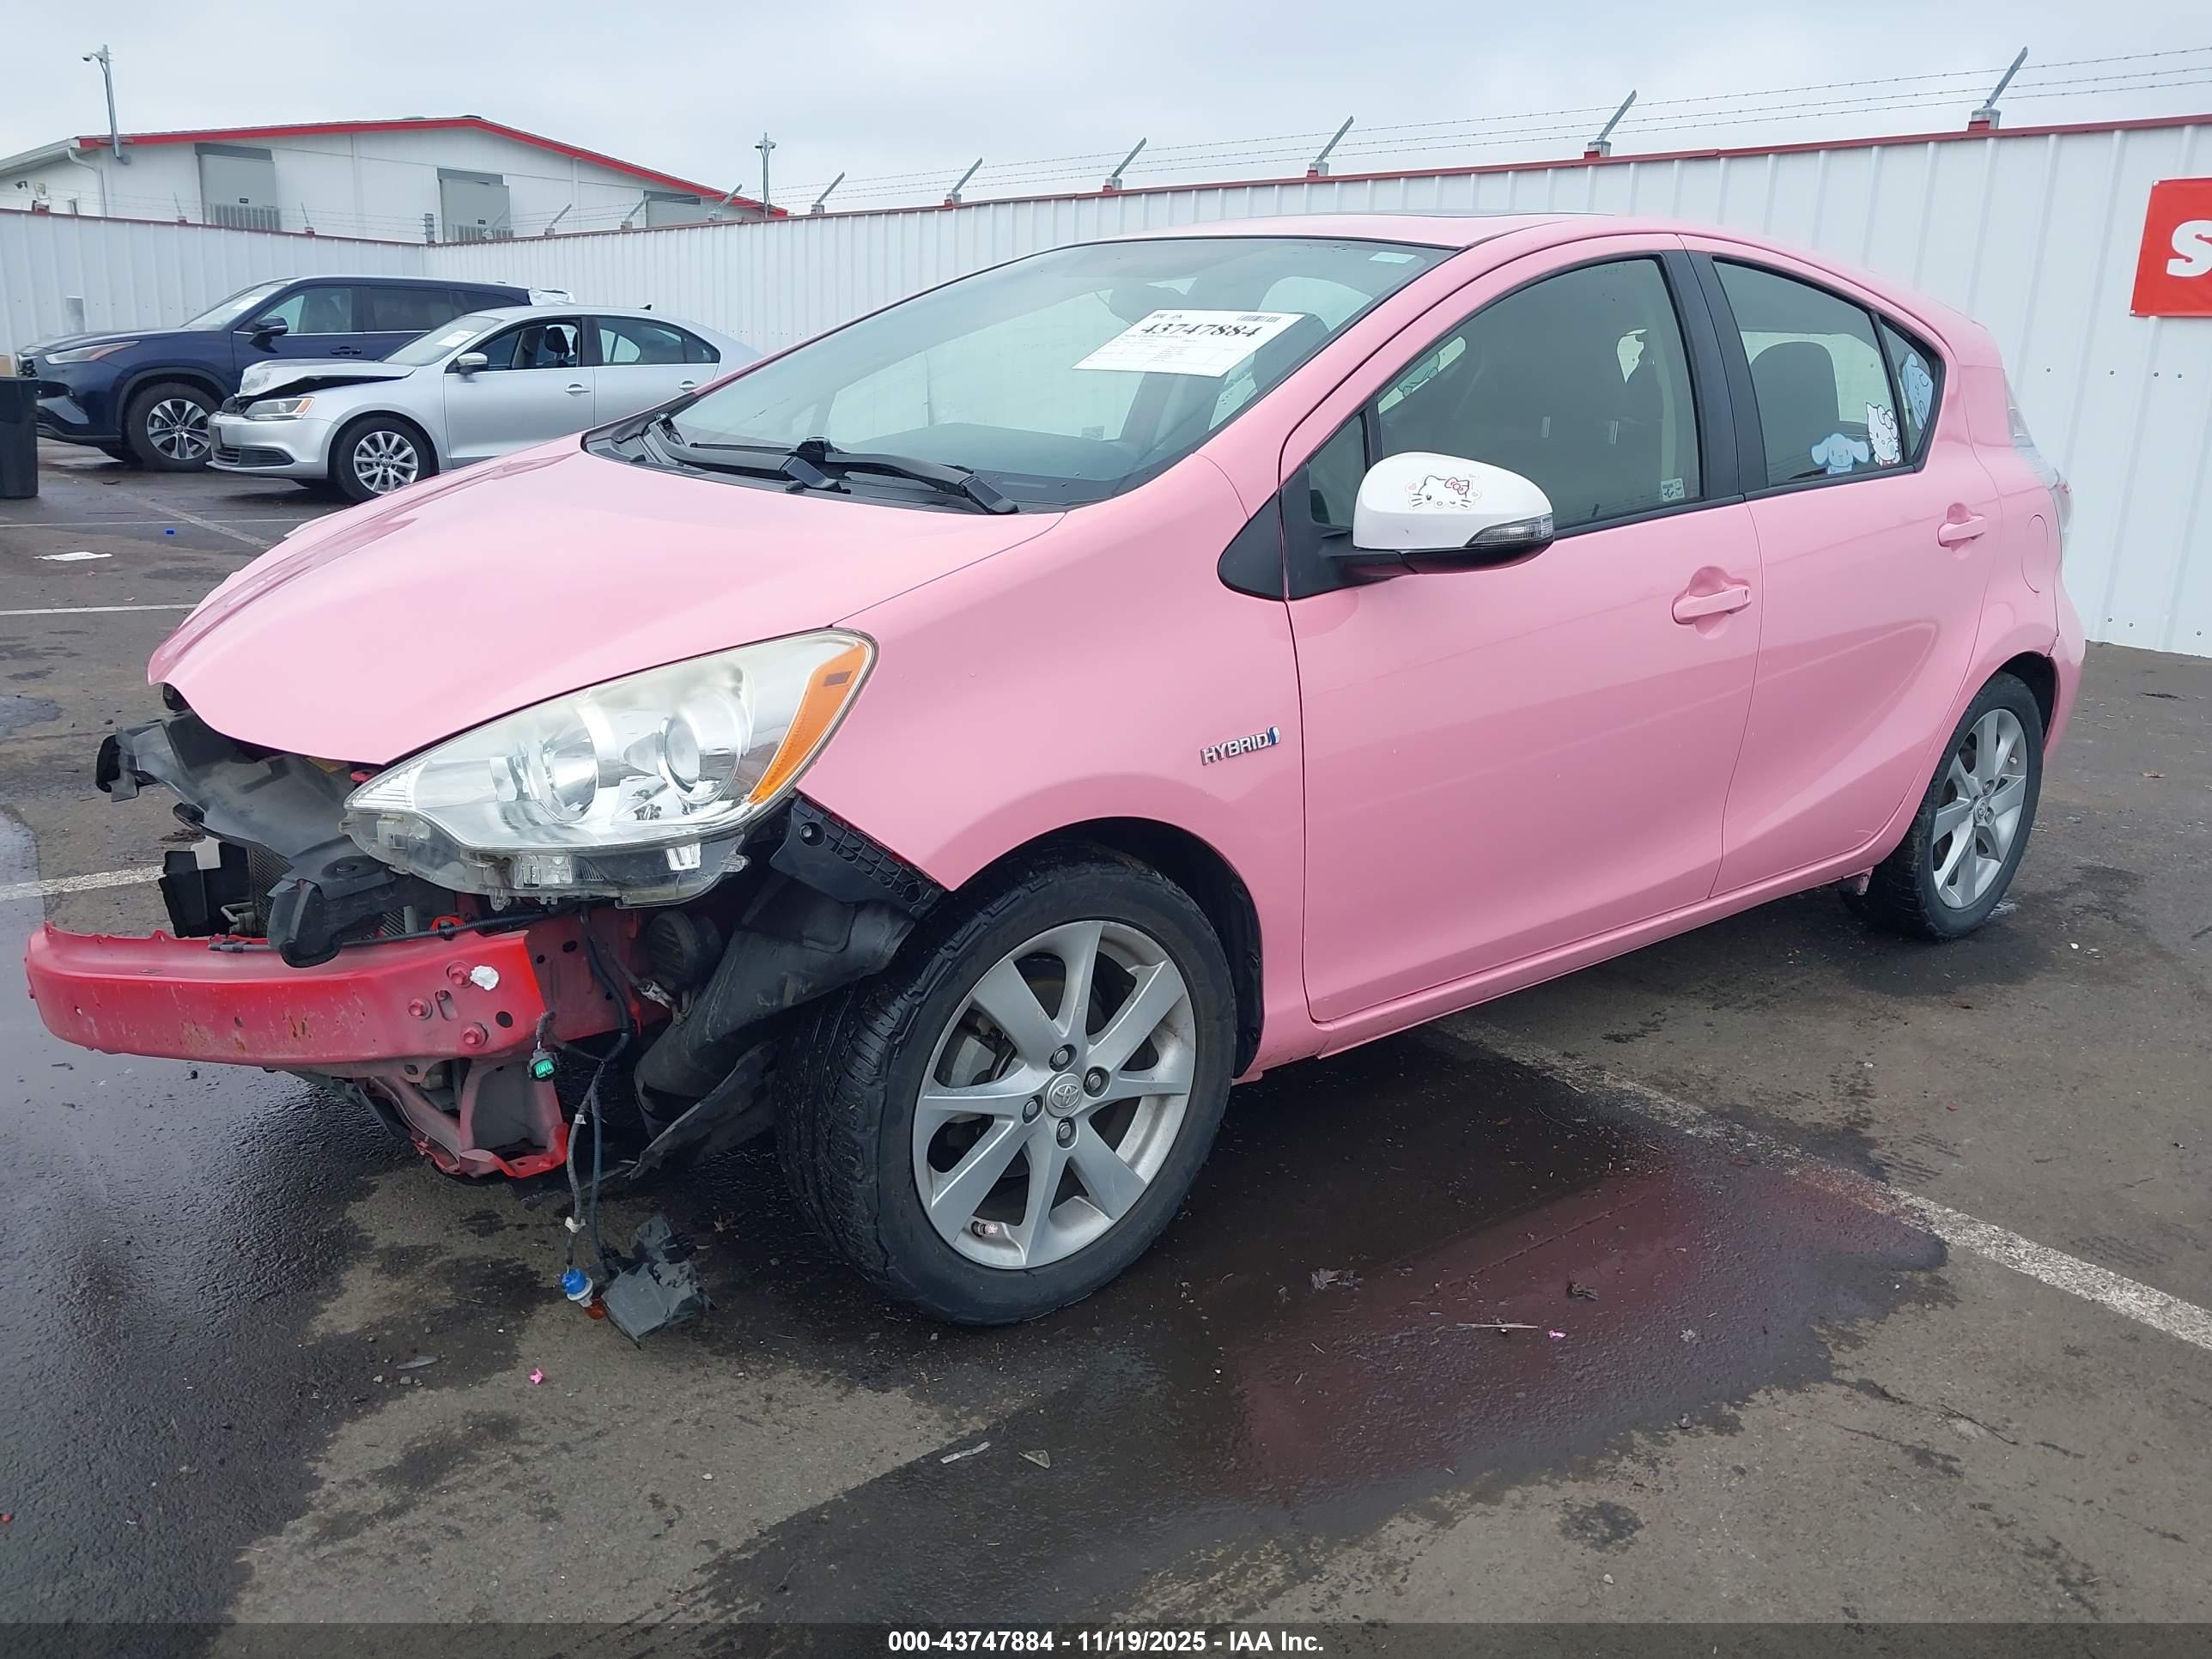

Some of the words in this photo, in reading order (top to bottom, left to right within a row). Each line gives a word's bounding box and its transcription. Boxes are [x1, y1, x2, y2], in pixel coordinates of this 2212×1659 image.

[2166, 220, 2212, 277] S
[1140, 323, 1263, 337] 43747884
[1201, 732, 1272, 765] HYBRID
